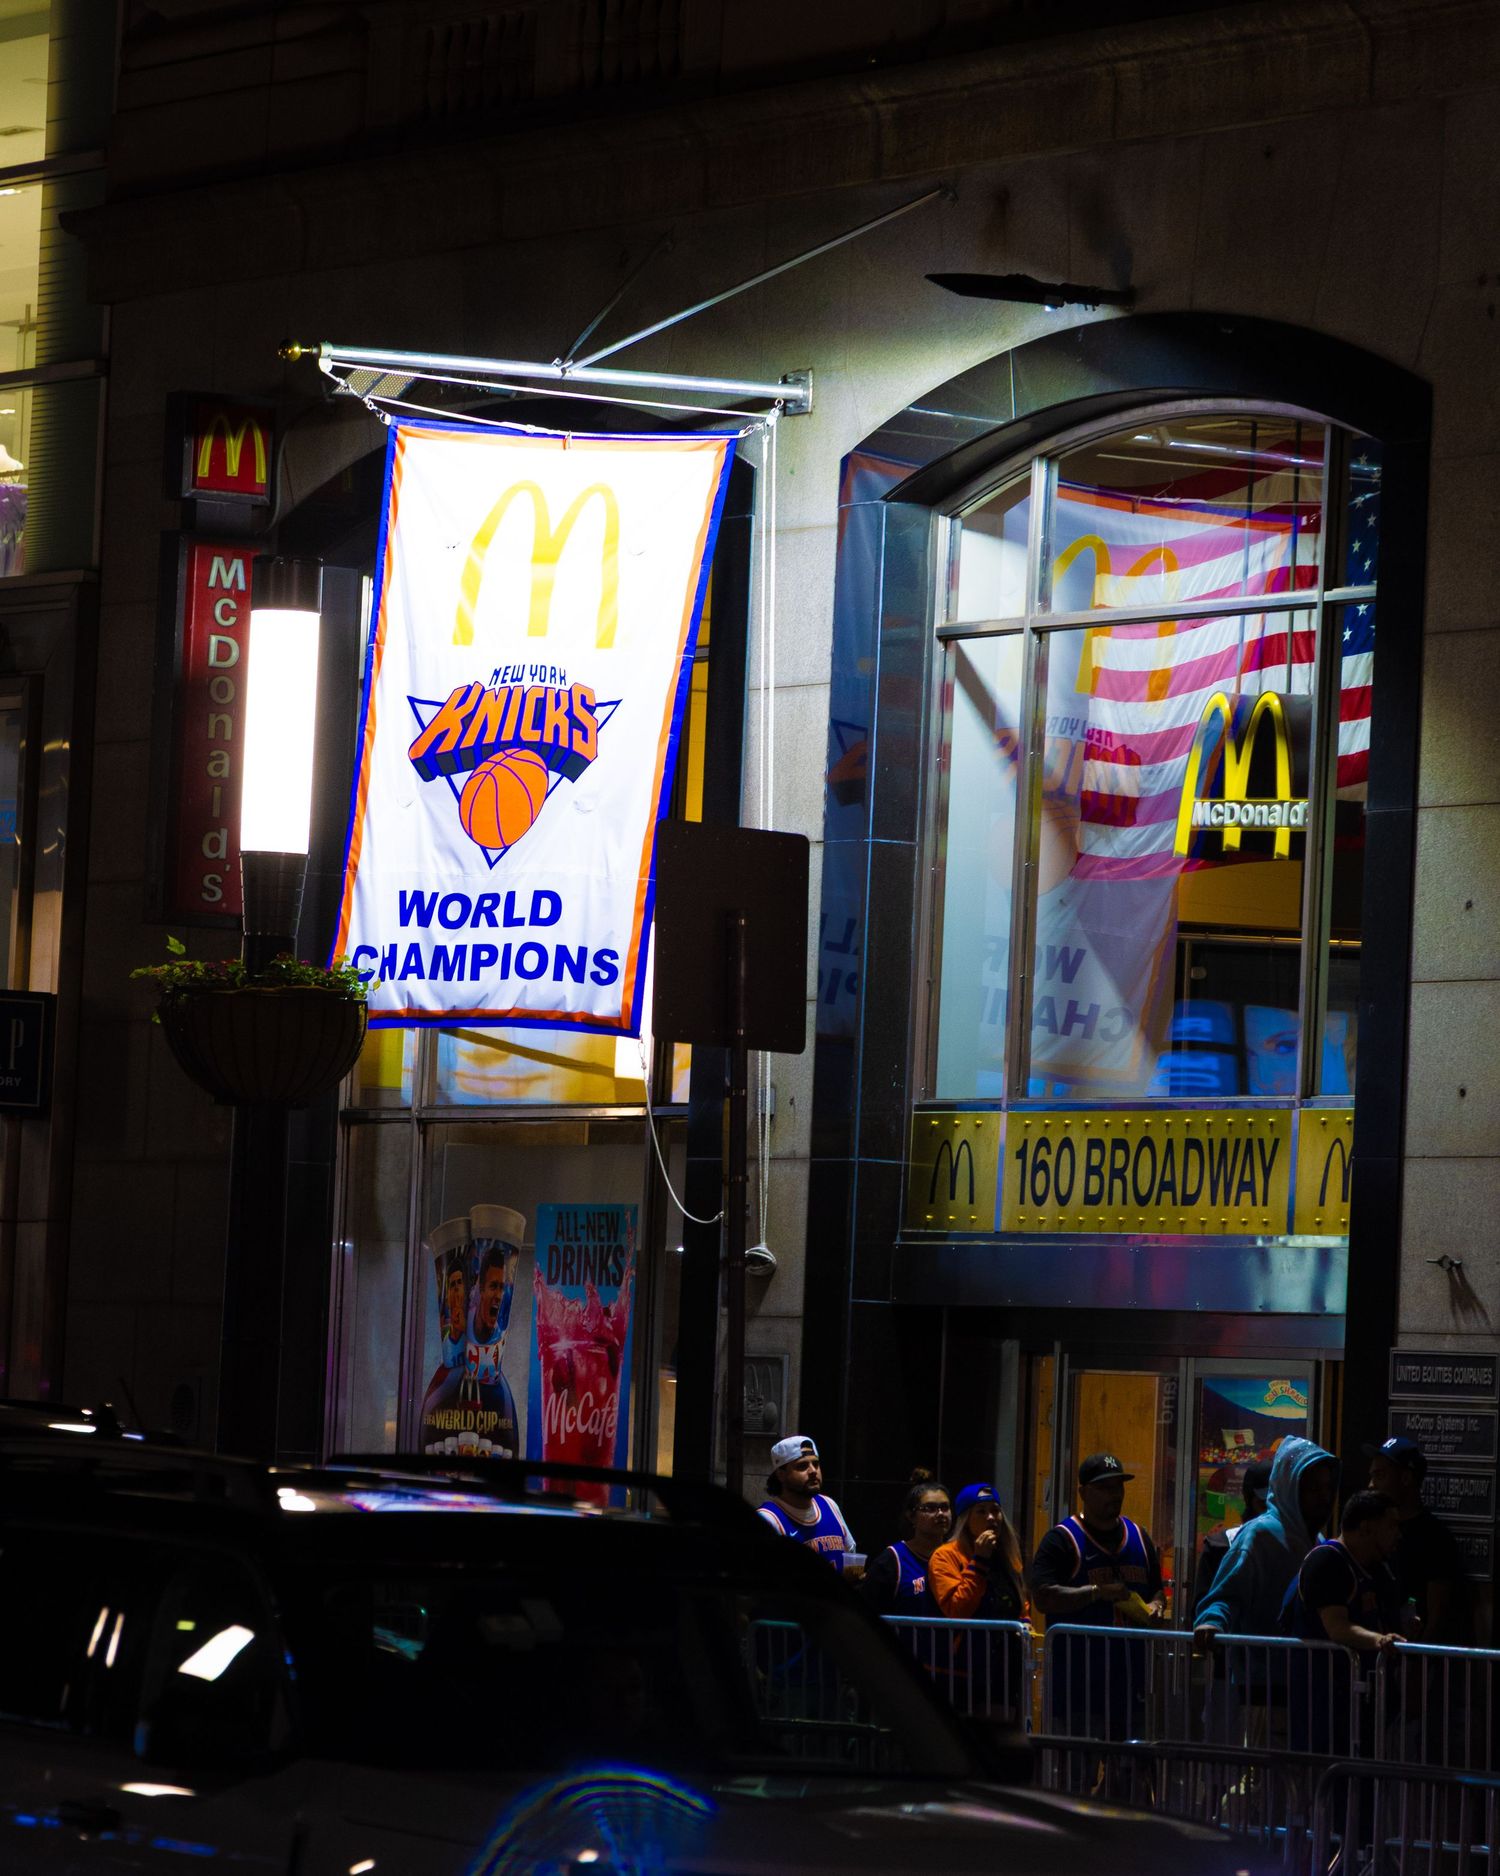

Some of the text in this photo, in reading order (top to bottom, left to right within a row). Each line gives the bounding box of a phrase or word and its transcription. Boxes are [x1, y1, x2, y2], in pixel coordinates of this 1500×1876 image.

[488, 664, 567, 686] NEW YORK
[202, 555, 247, 903] McDonald's
[408, 681, 599, 764] KNICKS
[399, 890, 562, 929] WORLD
[352, 942, 619, 986] CHAMPIONS
[1015, 1137, 1280, 1207] 160 BROADWAY
[556, 1211, 620, 1242] ALL-NEW
[546, 1244, 625, 1287] DRINKS
[1396, 1365, 1493, 1385] UNITED EQUITIES COMPANIES
[436, 1409, 475, 1431] WORLD
[476, 1411, 498, 1433] CUP
[544, 1388, 618, 1447] McCafé
[1449, 1478, 1490, 1497] BROADWAY
